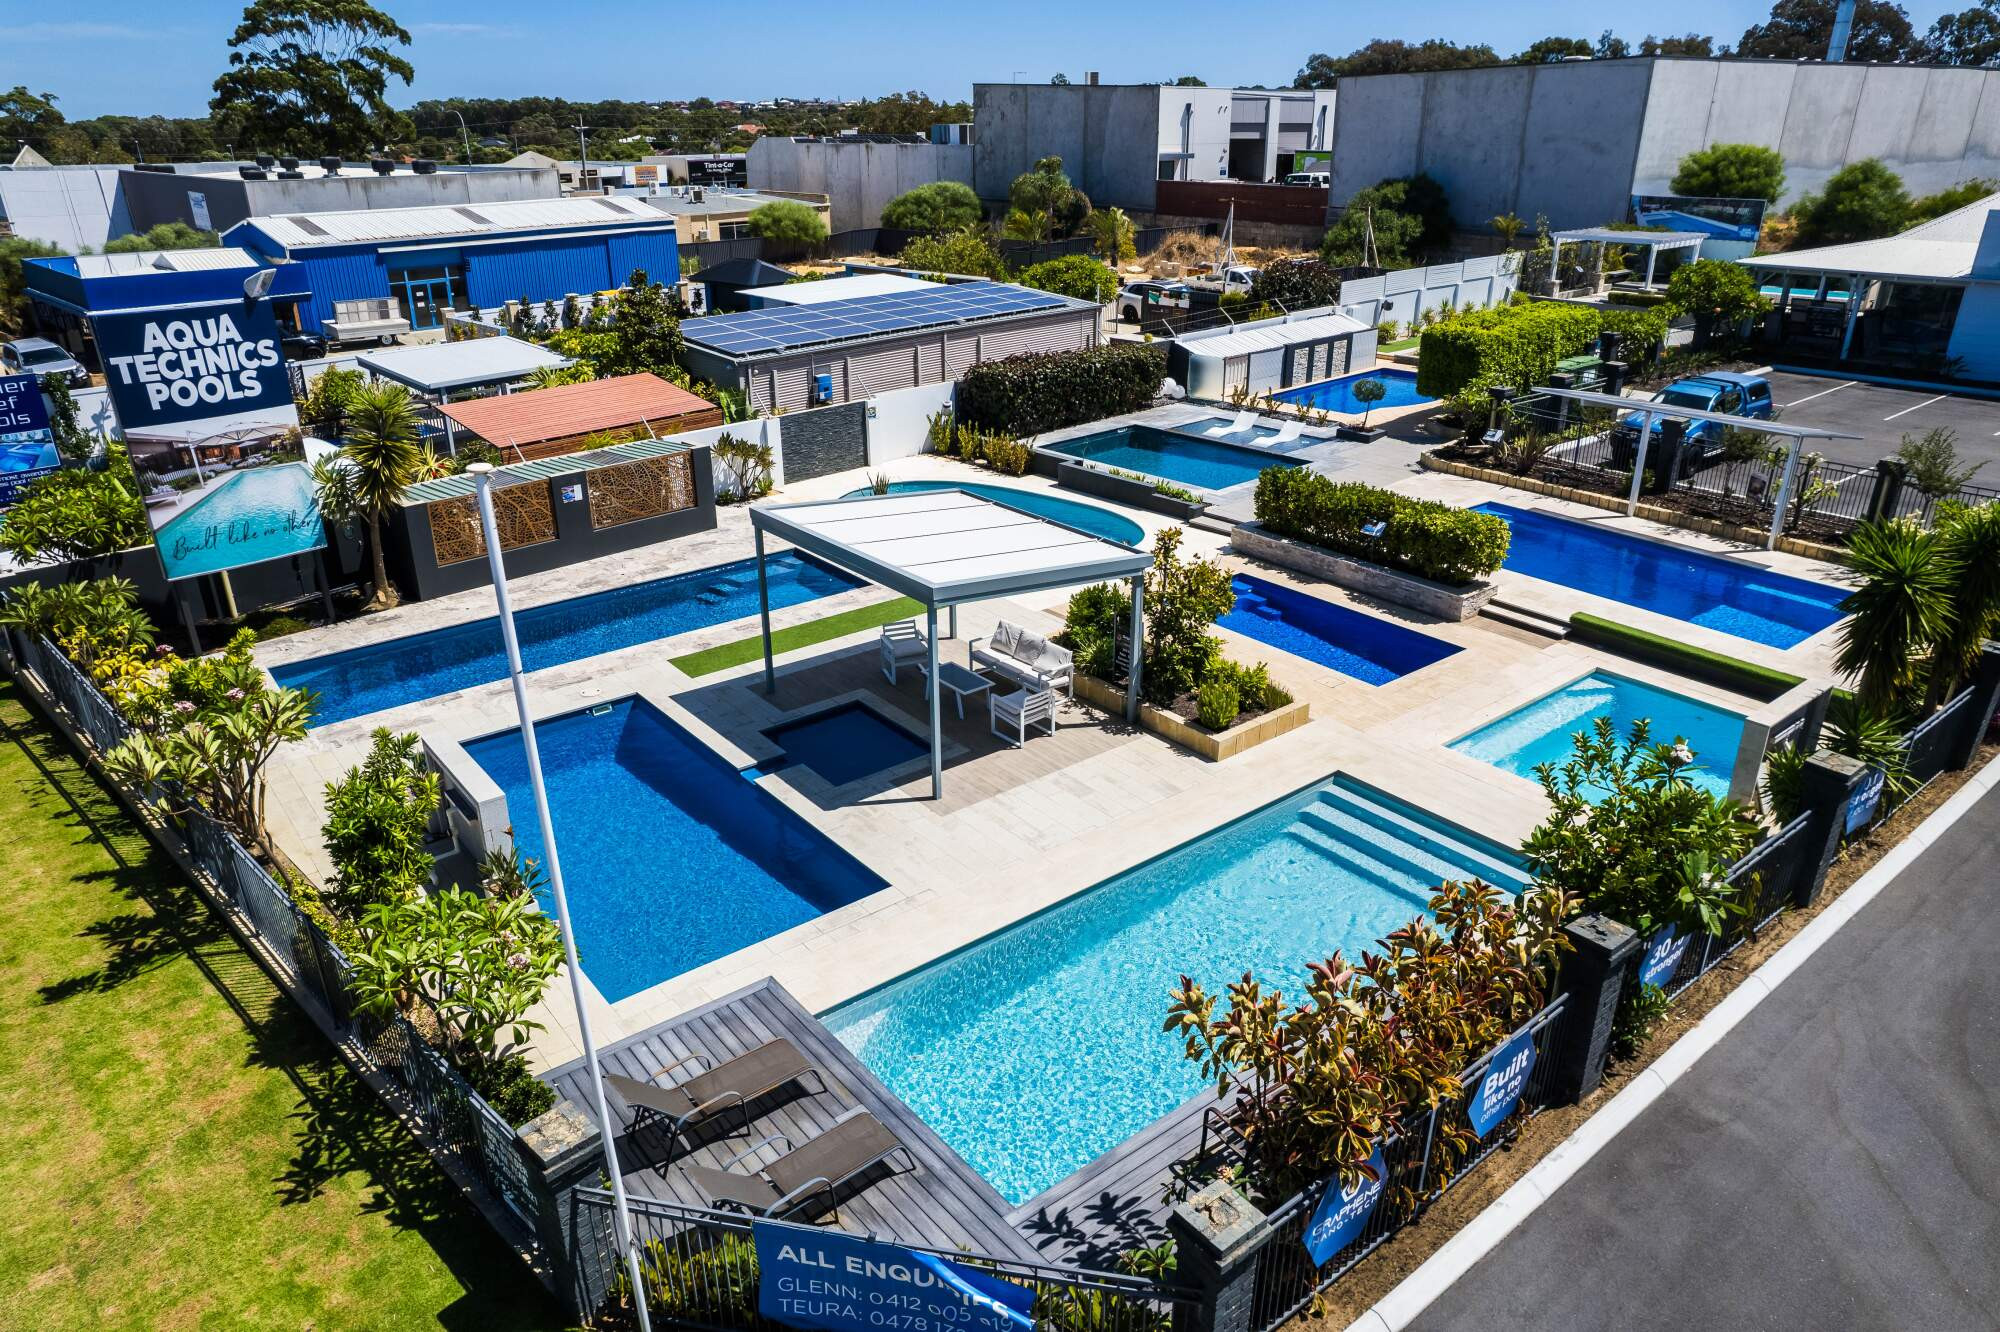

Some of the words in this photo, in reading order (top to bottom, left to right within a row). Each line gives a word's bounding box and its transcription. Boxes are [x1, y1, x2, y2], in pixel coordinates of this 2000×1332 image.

[144, 314, 243, 353] AQUA
[110, 340, 278, 385] TECHNICS
[0, 381, 28, 394] er
[146, 371, 262, 410] POOLS
[173, 526, 223, 560] Built
[229, 521, 257, 544] like
[264, 527, 278, 537] no
[283, 509, 312, 535] other
[1483, 1048, 1529, 1099] Built
[1484, 1089, 1505, 1111] like
[1507, 1075, 1522, 1092] no
[1481, 1102, 1502, 1123] other
[1312, 1180, 1381, 1236] GRAPHENE
[1312, 1193, 1378, 1247] NANO-TECH
[777, 1245, 836, 1269] ALL
[845, 1255, 1009, 1319] ENQUIES
[778, 1277, 862, 1300] GLENN:
[869, 1292, 921, 1311] 0412
[778, 1299, 862, 1321] TEURA:
[870, 1311, 928, 1332] 0478
[934, 1321, 967, 1332] 17
